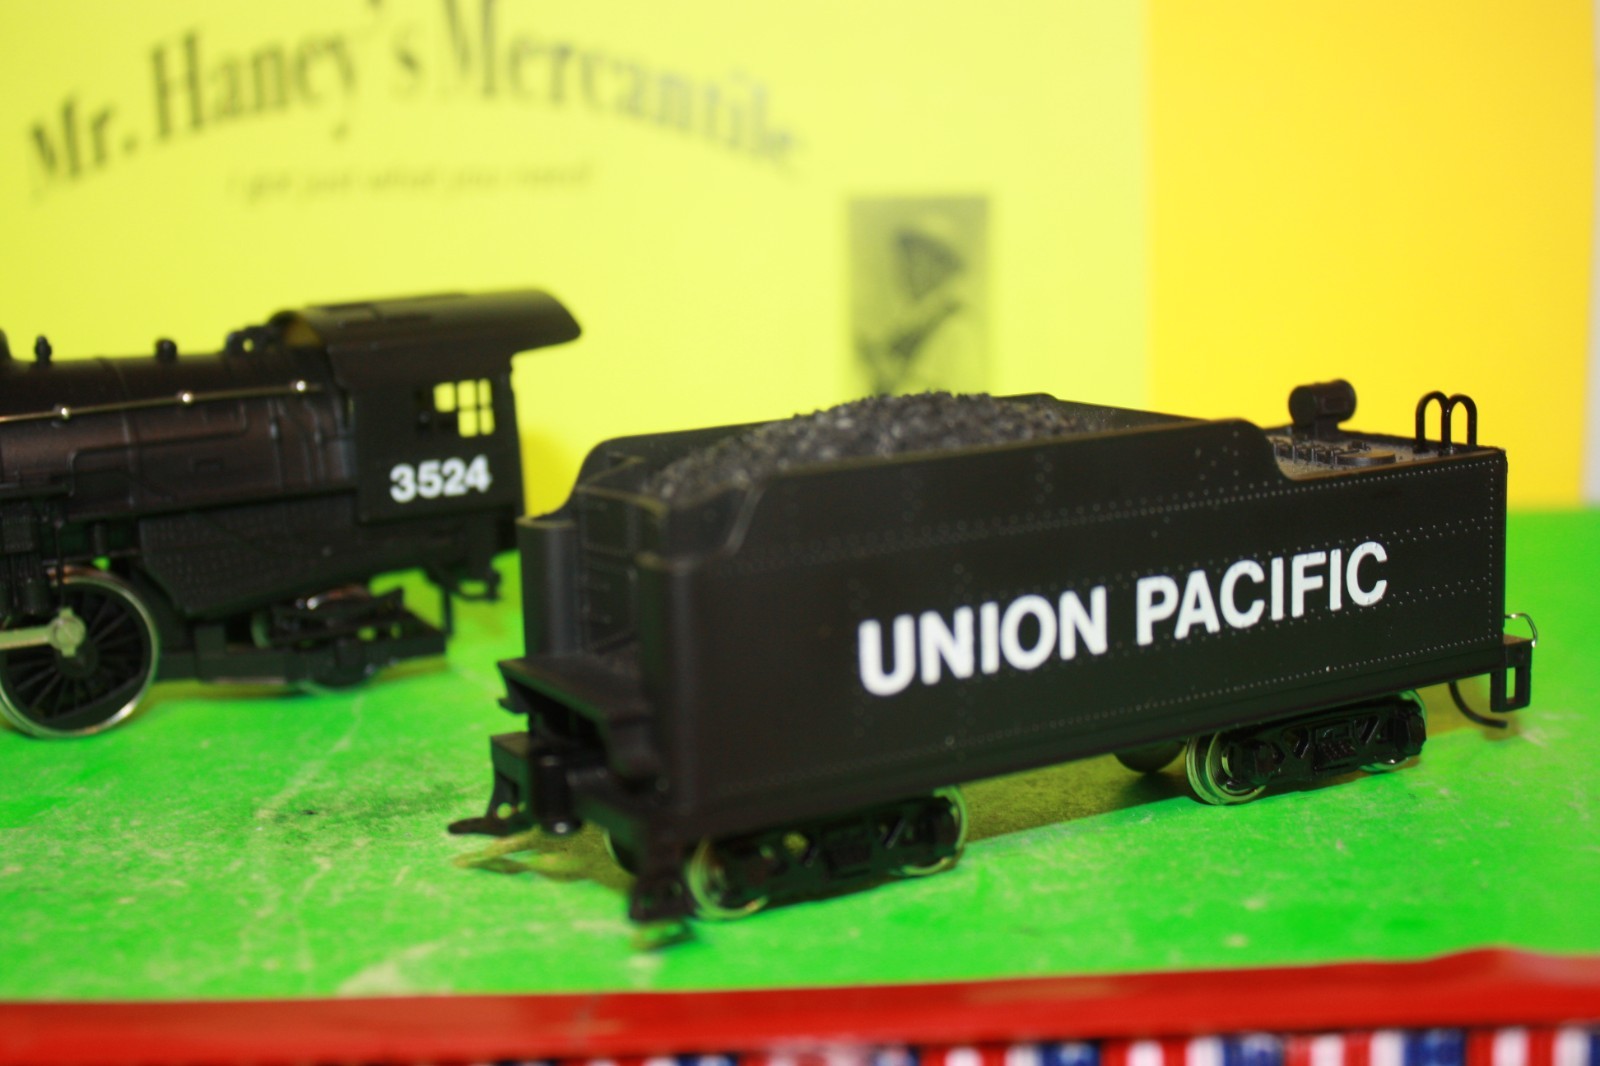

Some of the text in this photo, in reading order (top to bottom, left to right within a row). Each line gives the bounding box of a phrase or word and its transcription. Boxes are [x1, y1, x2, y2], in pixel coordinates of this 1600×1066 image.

[28, 92, 139, 198] Mr.
[438, 0, 806, 176] Mercantile
[389, 454, 492, 503] 3524
[858, 541, 1388, 696] UNION PACIFIC
